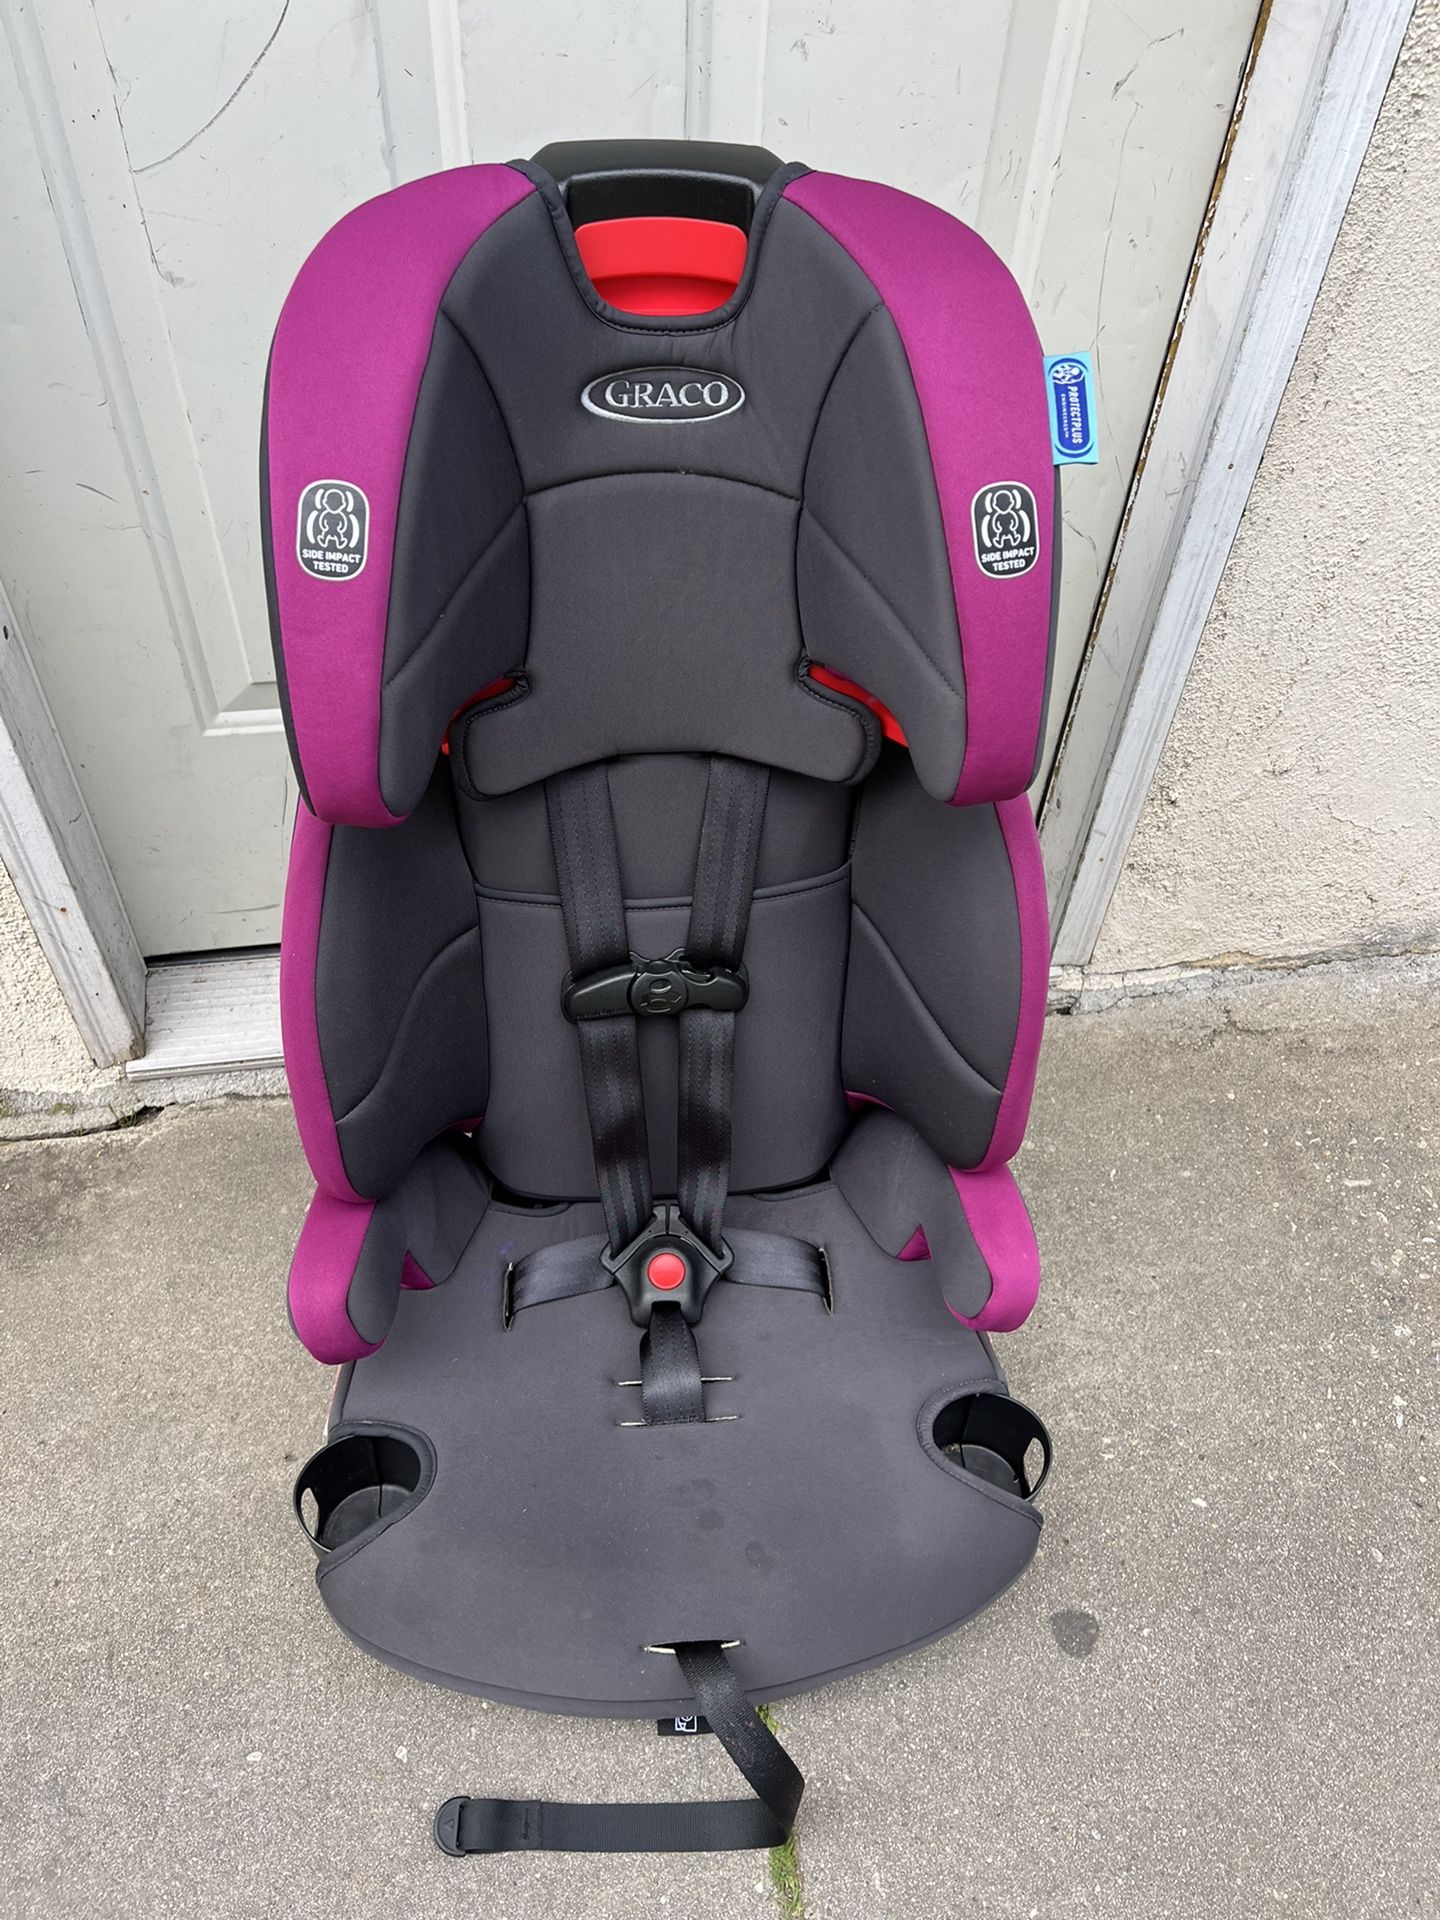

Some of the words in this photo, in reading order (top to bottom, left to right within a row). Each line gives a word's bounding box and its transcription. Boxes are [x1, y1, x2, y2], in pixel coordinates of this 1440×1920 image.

[604, 379, 729, 409] GRACO
[1067, 386, 1083, 445] PROTECTPLUS
[302, 548, 324, 560] SIDE
[325, 551, 361, 564] IMPACT
[981, 552, 1002, 563] SIDE
[1002, 546, 1035, 560] IMPACT
[313, 561, 349, 573] TESTED
[992, 559, 1026, 572] TESTED
